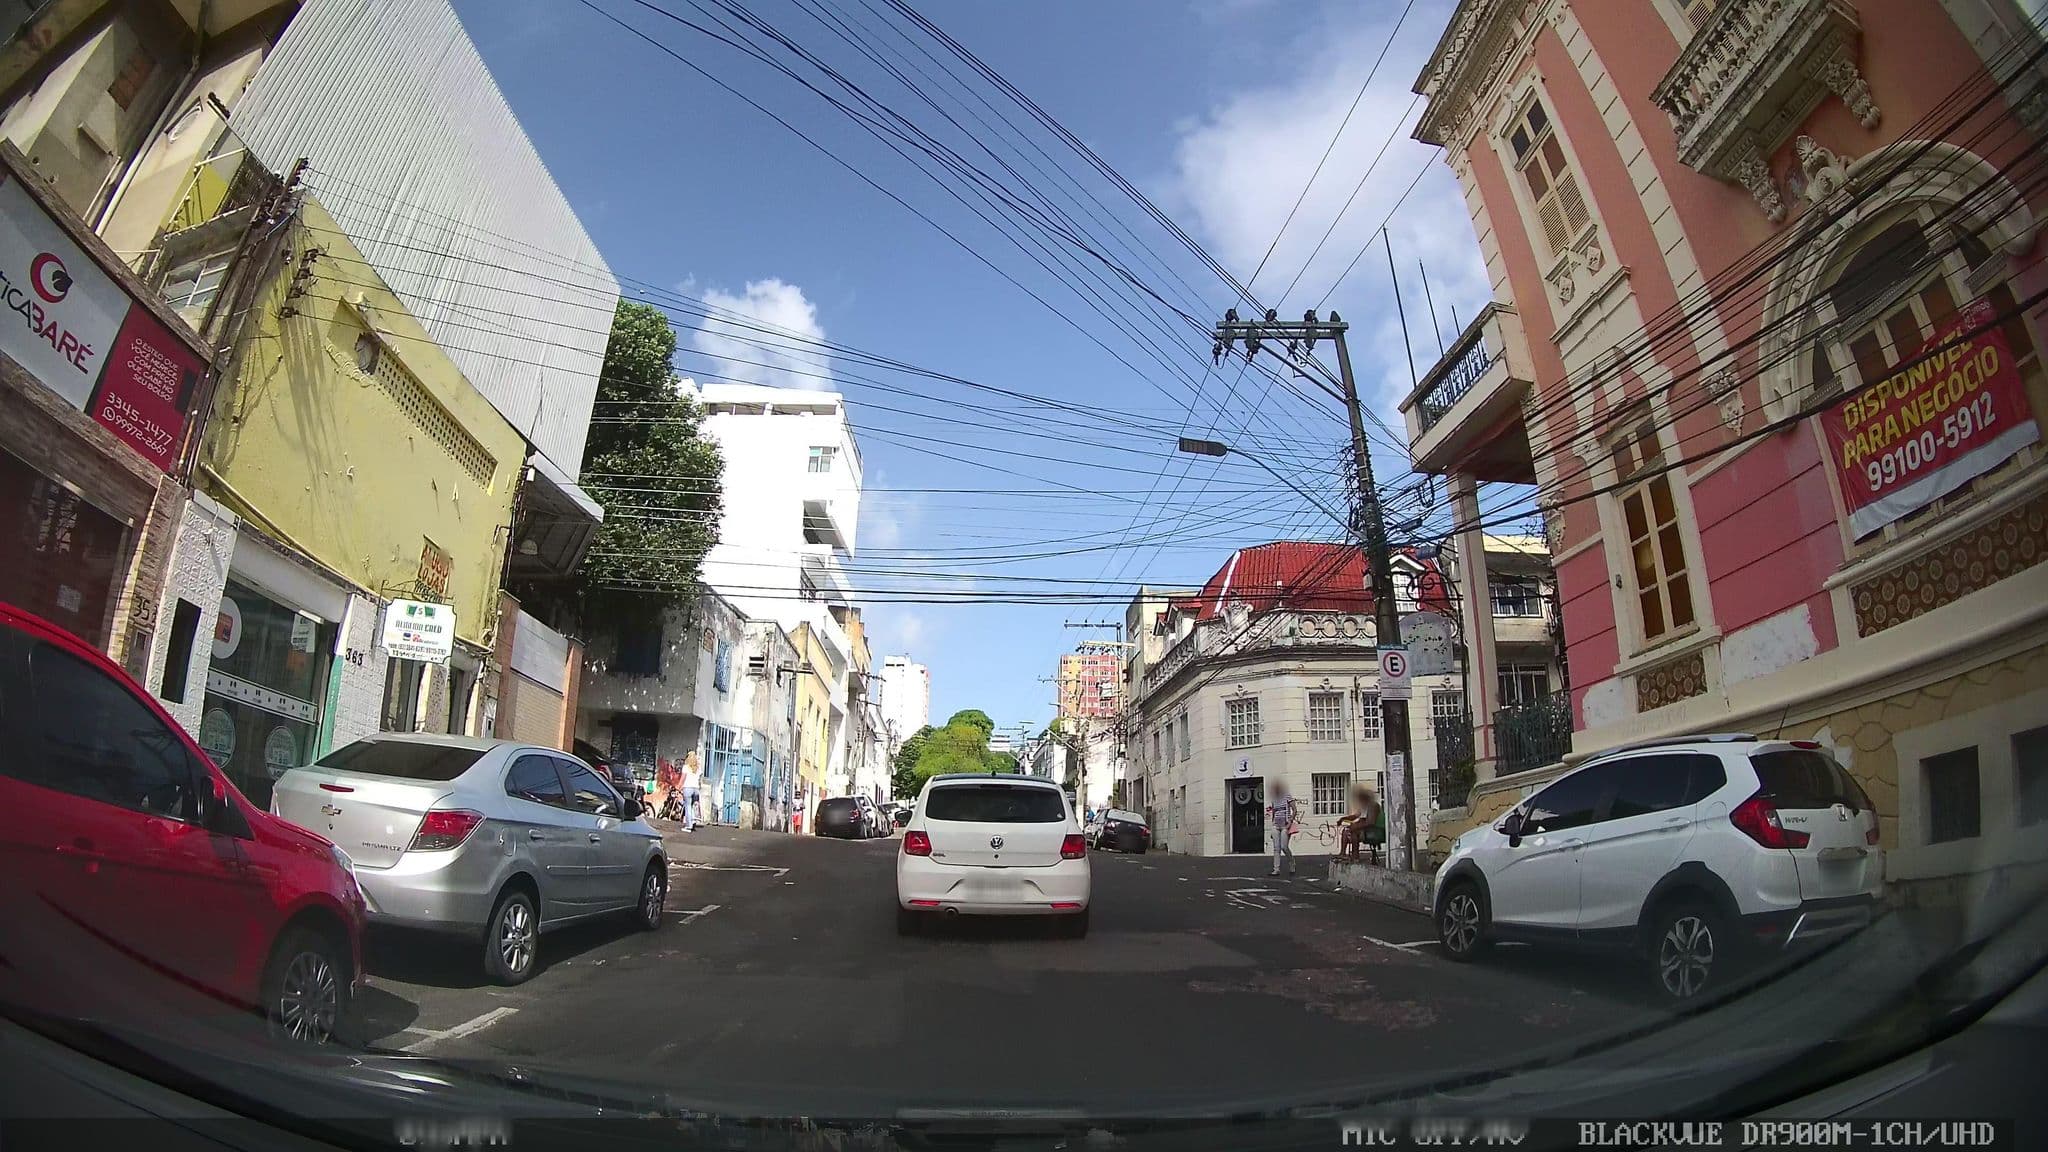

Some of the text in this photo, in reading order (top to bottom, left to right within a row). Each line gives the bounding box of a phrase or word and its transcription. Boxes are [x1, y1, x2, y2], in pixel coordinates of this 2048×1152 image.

[131, 343, 151, 361] VOCÊ
[164, 358, 178, 371] QUE
[126, 360, 174, 394] QUE CABE NO
[132, 373, 147, 386] SEU
[134, 355, 176, 386] COM PREÇO
[106, 391, 173, 447] 3345-1477
[1843, 344, 2000, 469] PARA NEGÓCIO
[115, 415, 167, 457] 99972-2667
[1866, 391, 1997, 492] 99100-5912
[417, 566, 446, 593] LOJAS
[345, 647, 364, 666] 363
[1389, 656, 1400, 672] E
